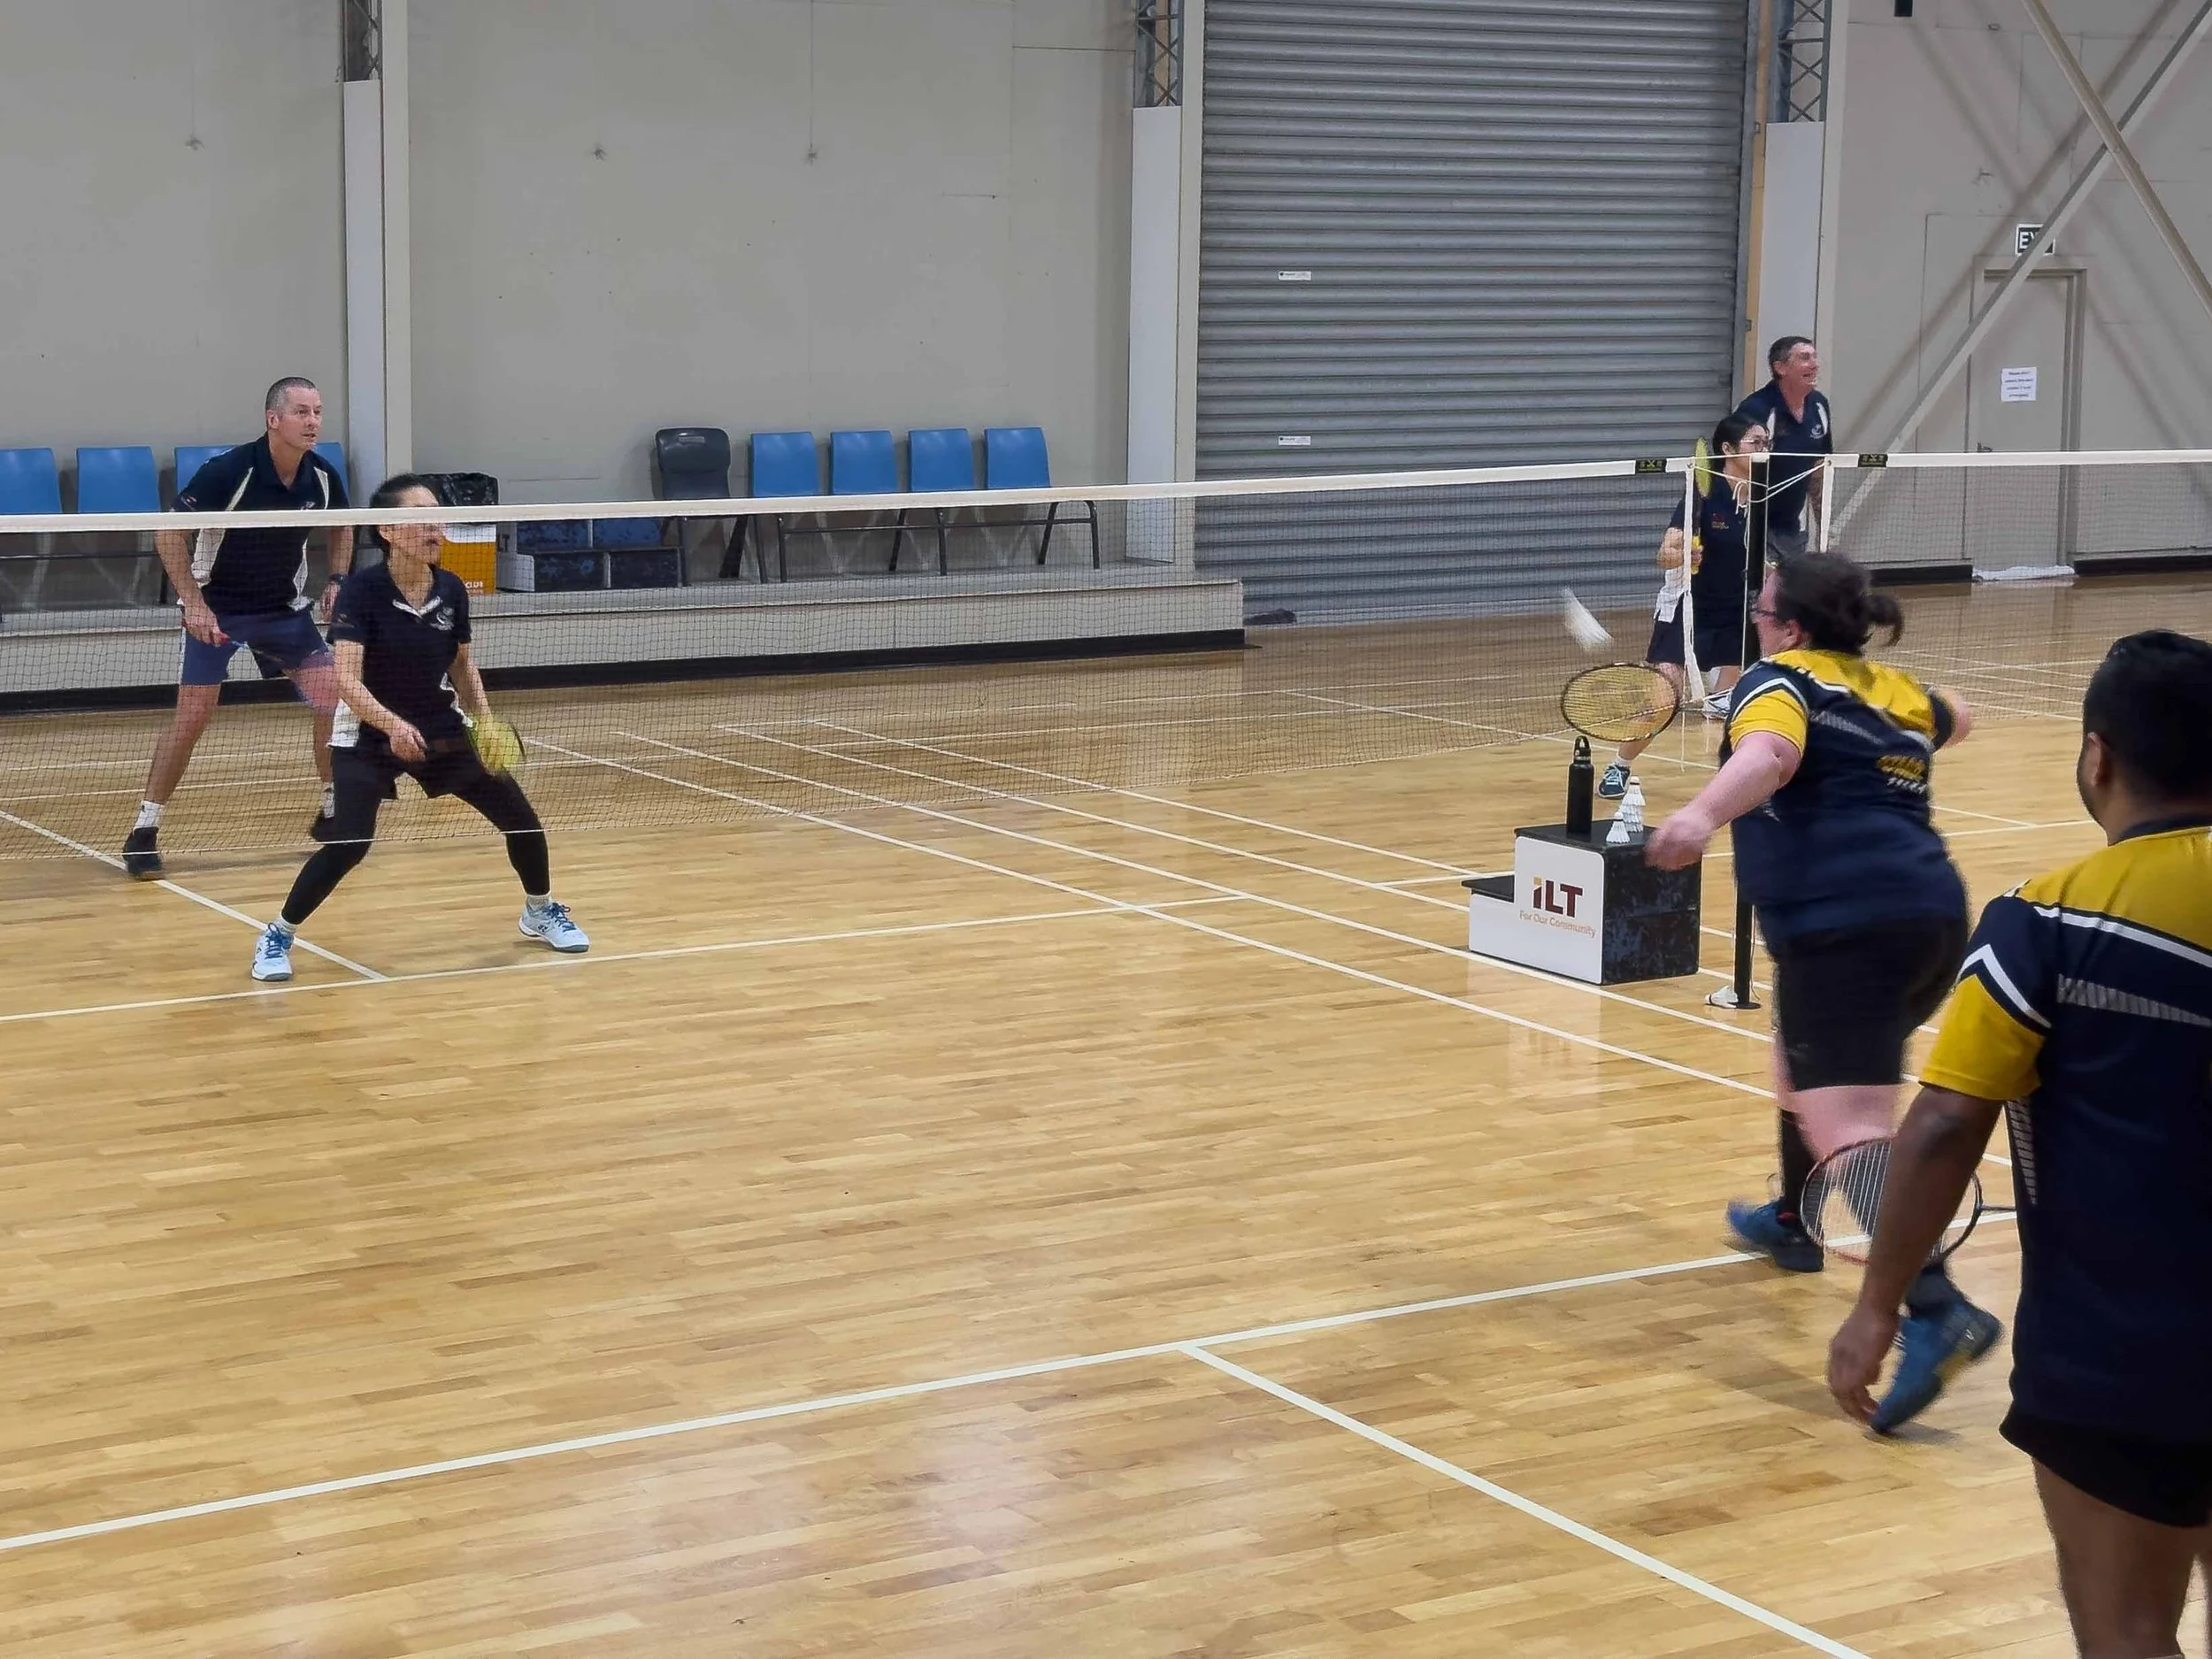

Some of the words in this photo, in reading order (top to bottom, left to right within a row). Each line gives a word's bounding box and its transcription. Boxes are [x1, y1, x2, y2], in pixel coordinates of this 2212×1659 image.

[1519, 910, 1532, 921] For
[1533, 913, 1548, 925] Our
[1549, 918, 1596, 938] Community
